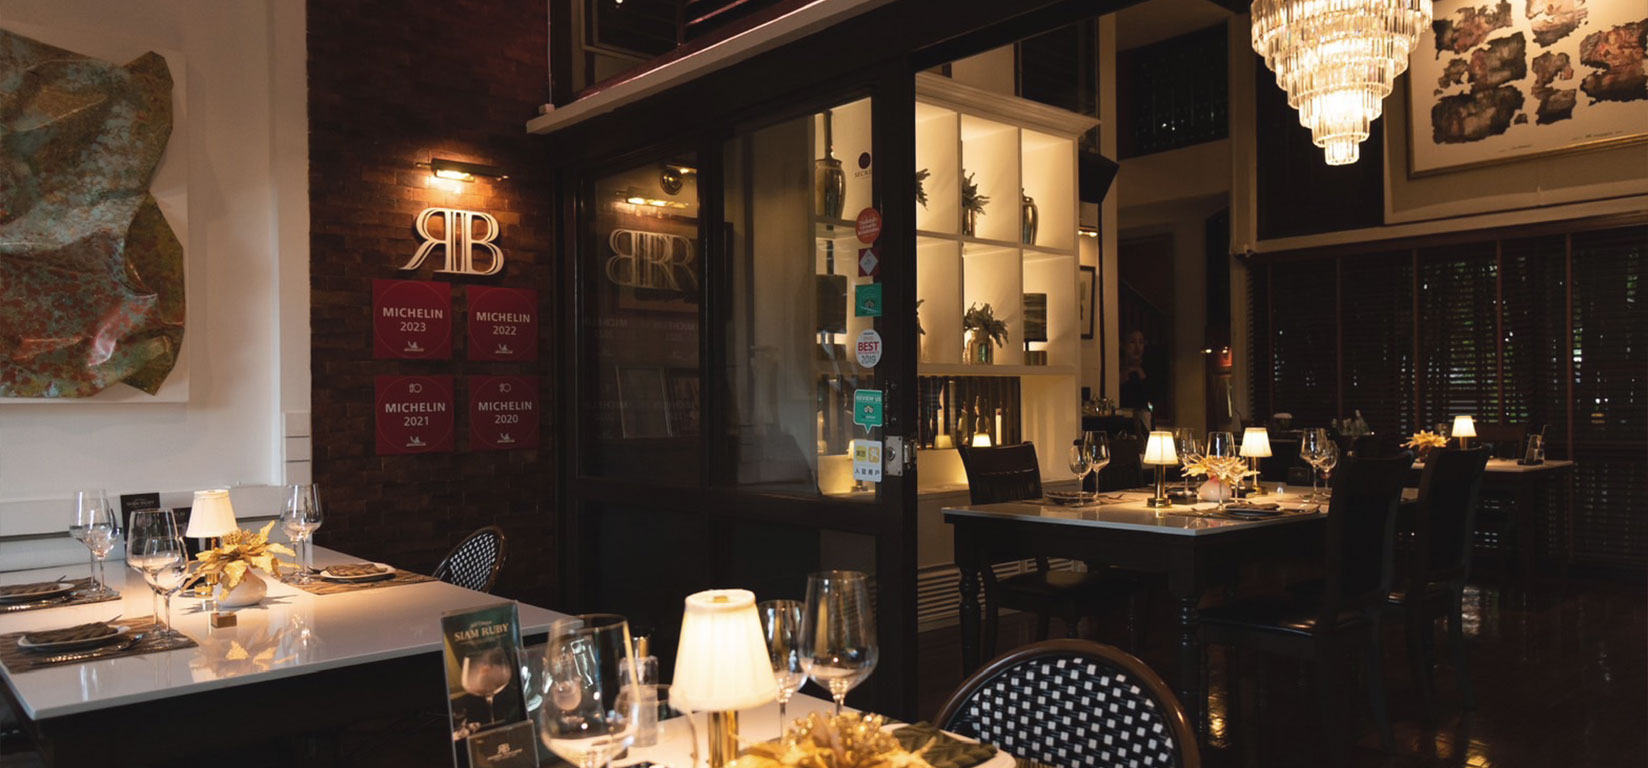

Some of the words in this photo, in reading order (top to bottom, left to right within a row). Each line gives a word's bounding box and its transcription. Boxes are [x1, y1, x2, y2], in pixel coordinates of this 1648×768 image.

[382, 307, 444, 319] MICHELIN
[476, 312, 531, 323] MICHELIN
[400, 321, 427, 332] 2023
[492, 325, 517, 336] 2022
[857, 341, 880, 352] BEST
[860, 355, 877, 364] 2019
[385, 402, 446, 414] MICHELIN
[478, 401, 533, 412] MICHELIN
[403, 416, 430, 427] 2021
[494, 414, 519, 424] 2020
[454, 629, 480, 642] SIAM
[482, 623, 509, 637] RUBY
